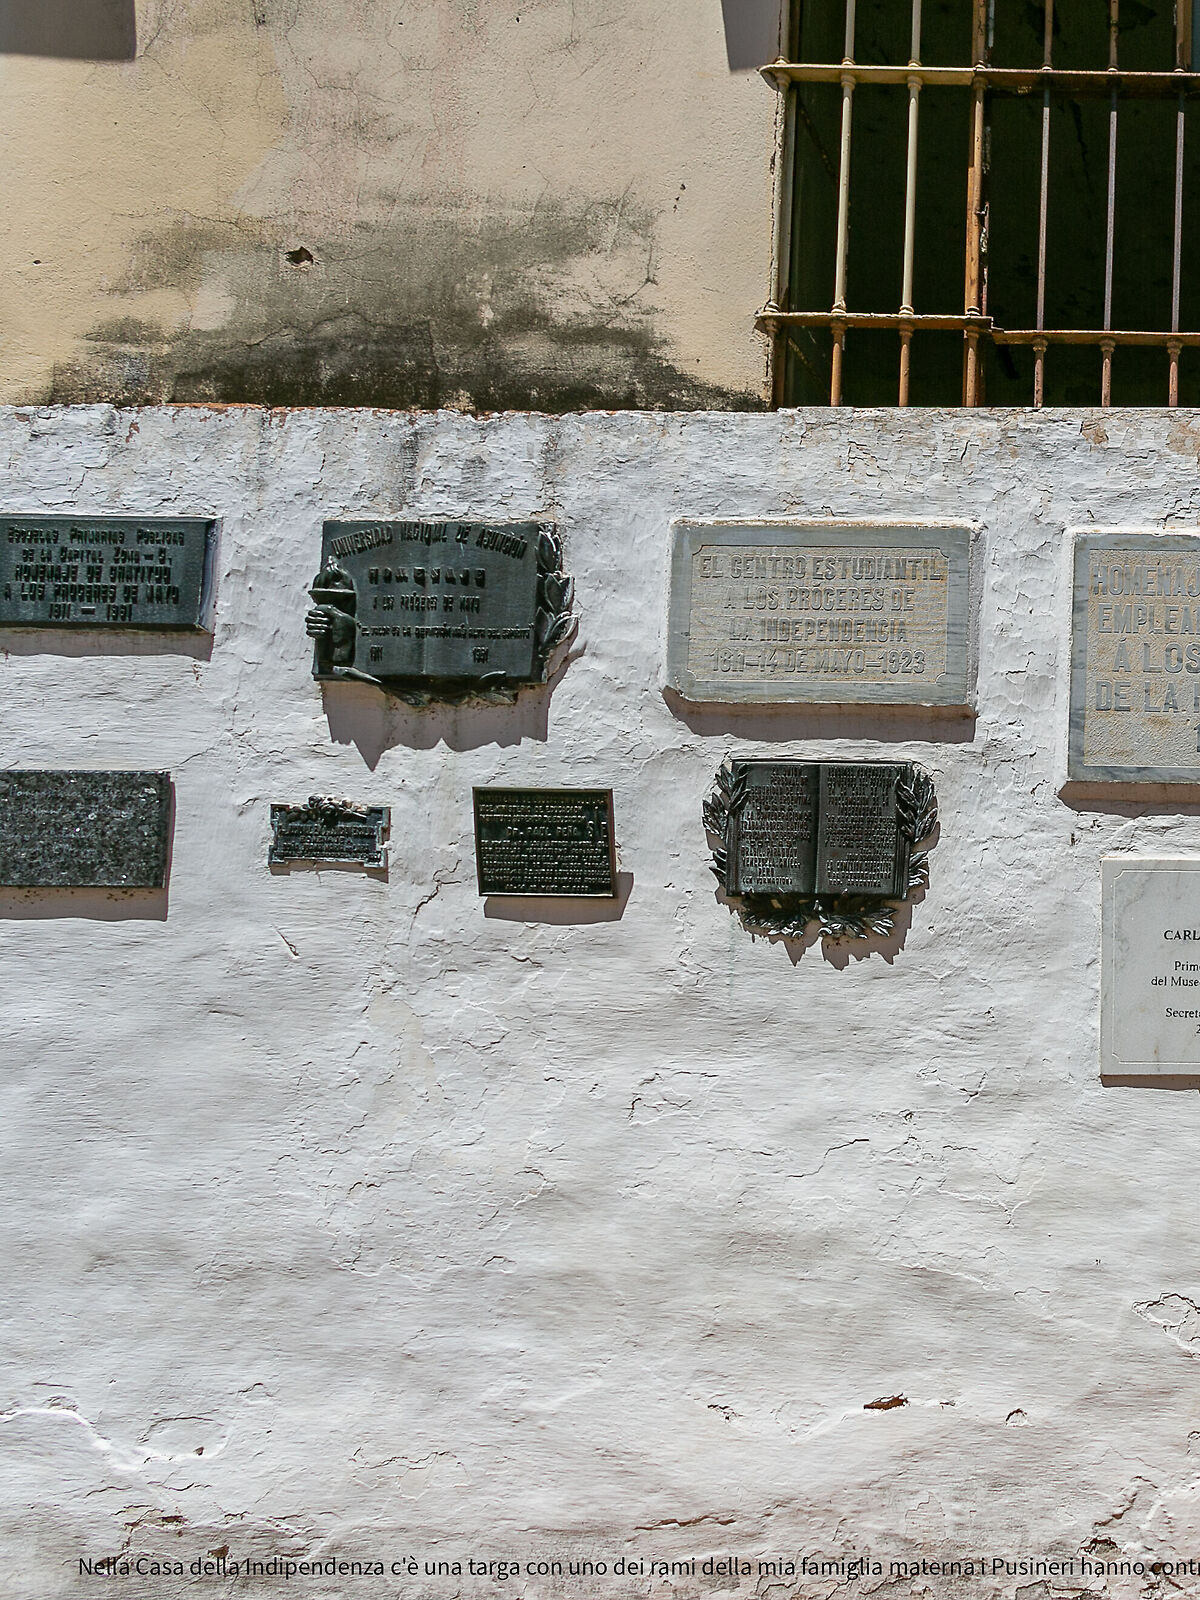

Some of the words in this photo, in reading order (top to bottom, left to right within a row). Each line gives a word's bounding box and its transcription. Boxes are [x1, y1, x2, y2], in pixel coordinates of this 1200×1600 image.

[331, 525, 393, 559] UNIVERSIDAD
[455, 524, 472, 544] DE
[700, 555, 723, 578] EL
[730, 555, 806, 578] CENTRO
[812, 556, 943, 580] ESTUDIANTIL
[744, 585, 779, 610] LOS
[786, 583, 885, 611] PRÓCERES
[890, 587, 915, 611] DE
[729, 617, 753, 641] LA
[760, 617, 909, 642] INDEPENDENCIA
[784, 650, 808, 673] DE
[1095, 680, 1132, 712] DE
[1151, 976, 1168, 987] del
